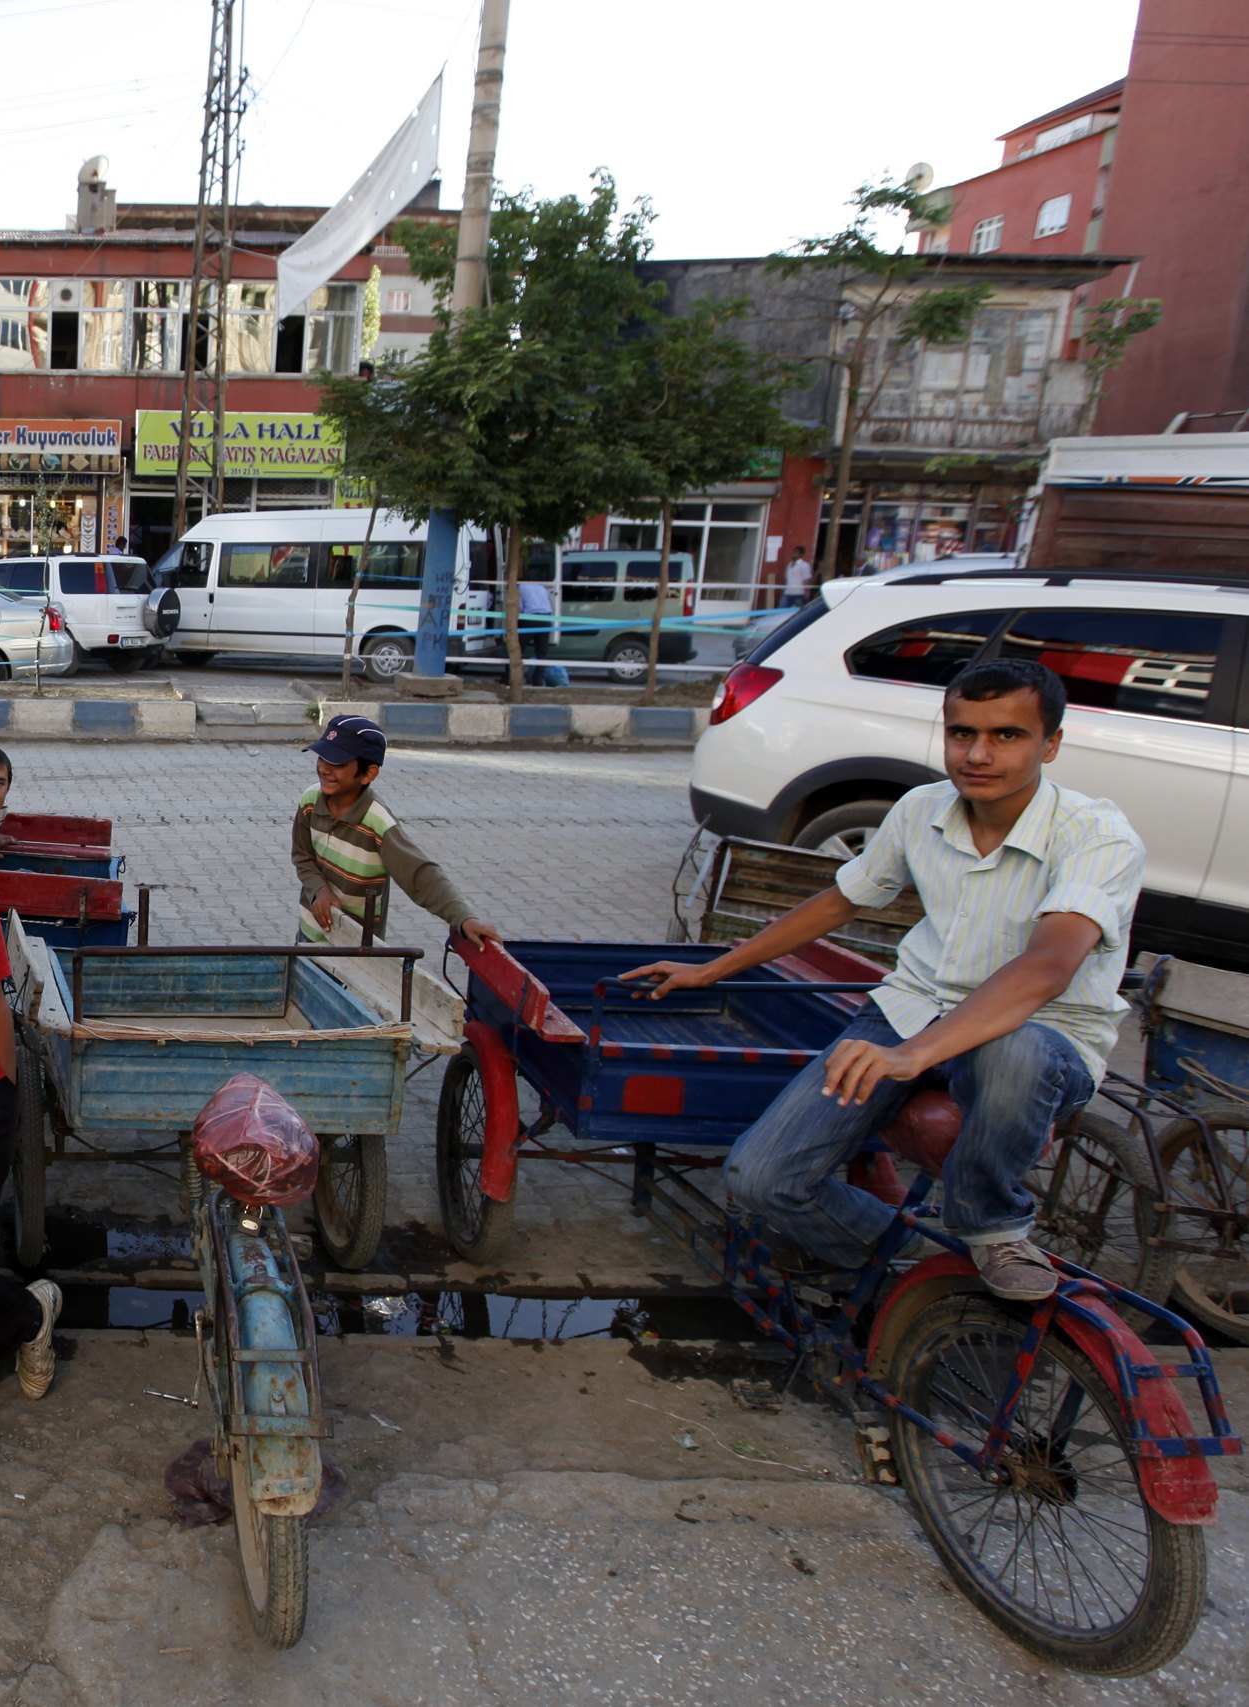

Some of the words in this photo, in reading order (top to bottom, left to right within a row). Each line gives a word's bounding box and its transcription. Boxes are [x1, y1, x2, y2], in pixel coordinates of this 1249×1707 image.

[15, 426, 117, 450] Kuyumculuk
[257, 422, 321, 440] HALI
[220, 446, 256, 467] ATIŞ
